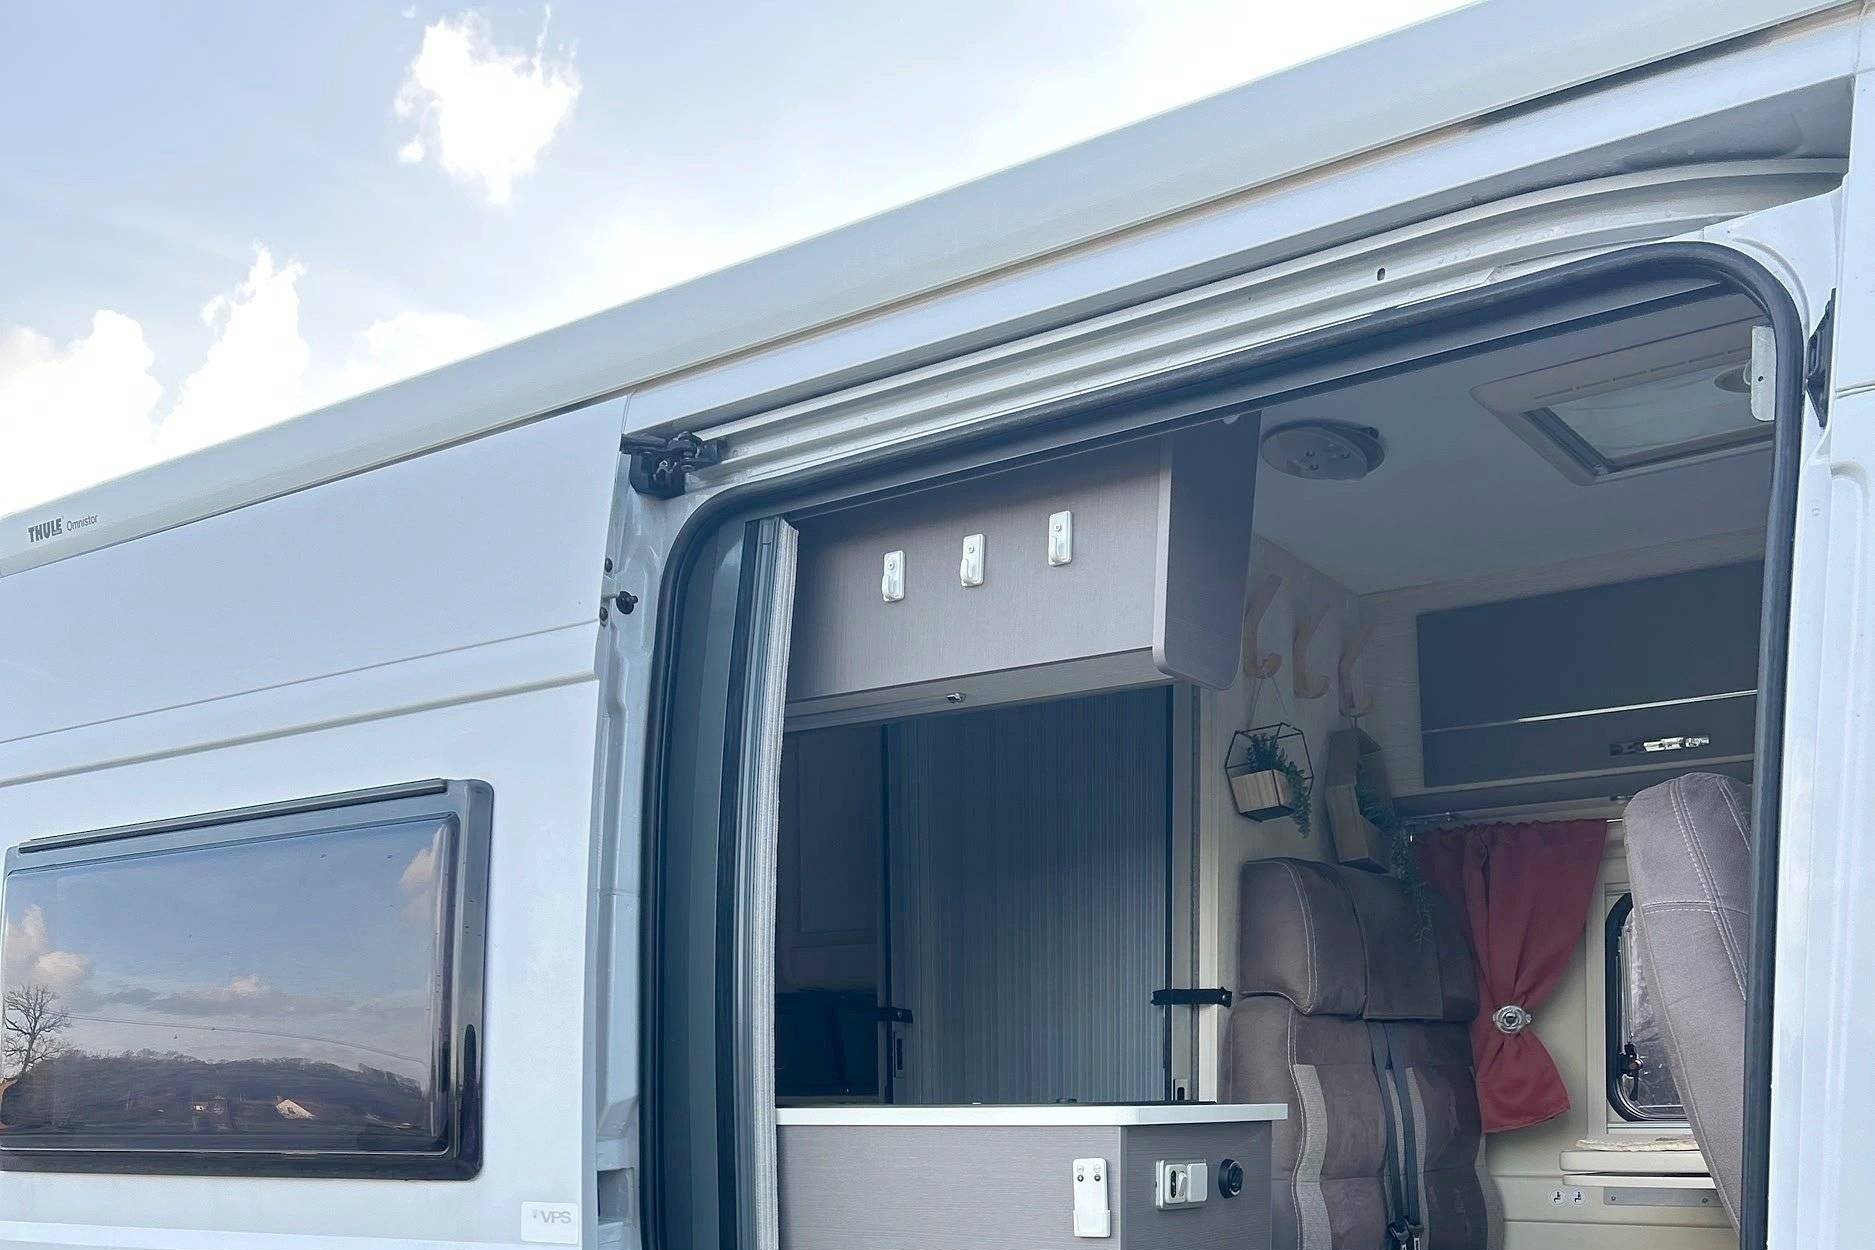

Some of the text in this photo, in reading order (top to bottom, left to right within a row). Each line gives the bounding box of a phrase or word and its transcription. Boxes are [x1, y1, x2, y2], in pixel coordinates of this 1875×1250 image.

[27, 514, 98, 543] THULE Omnistor
[540, 1210, 572, 1224] VPS
